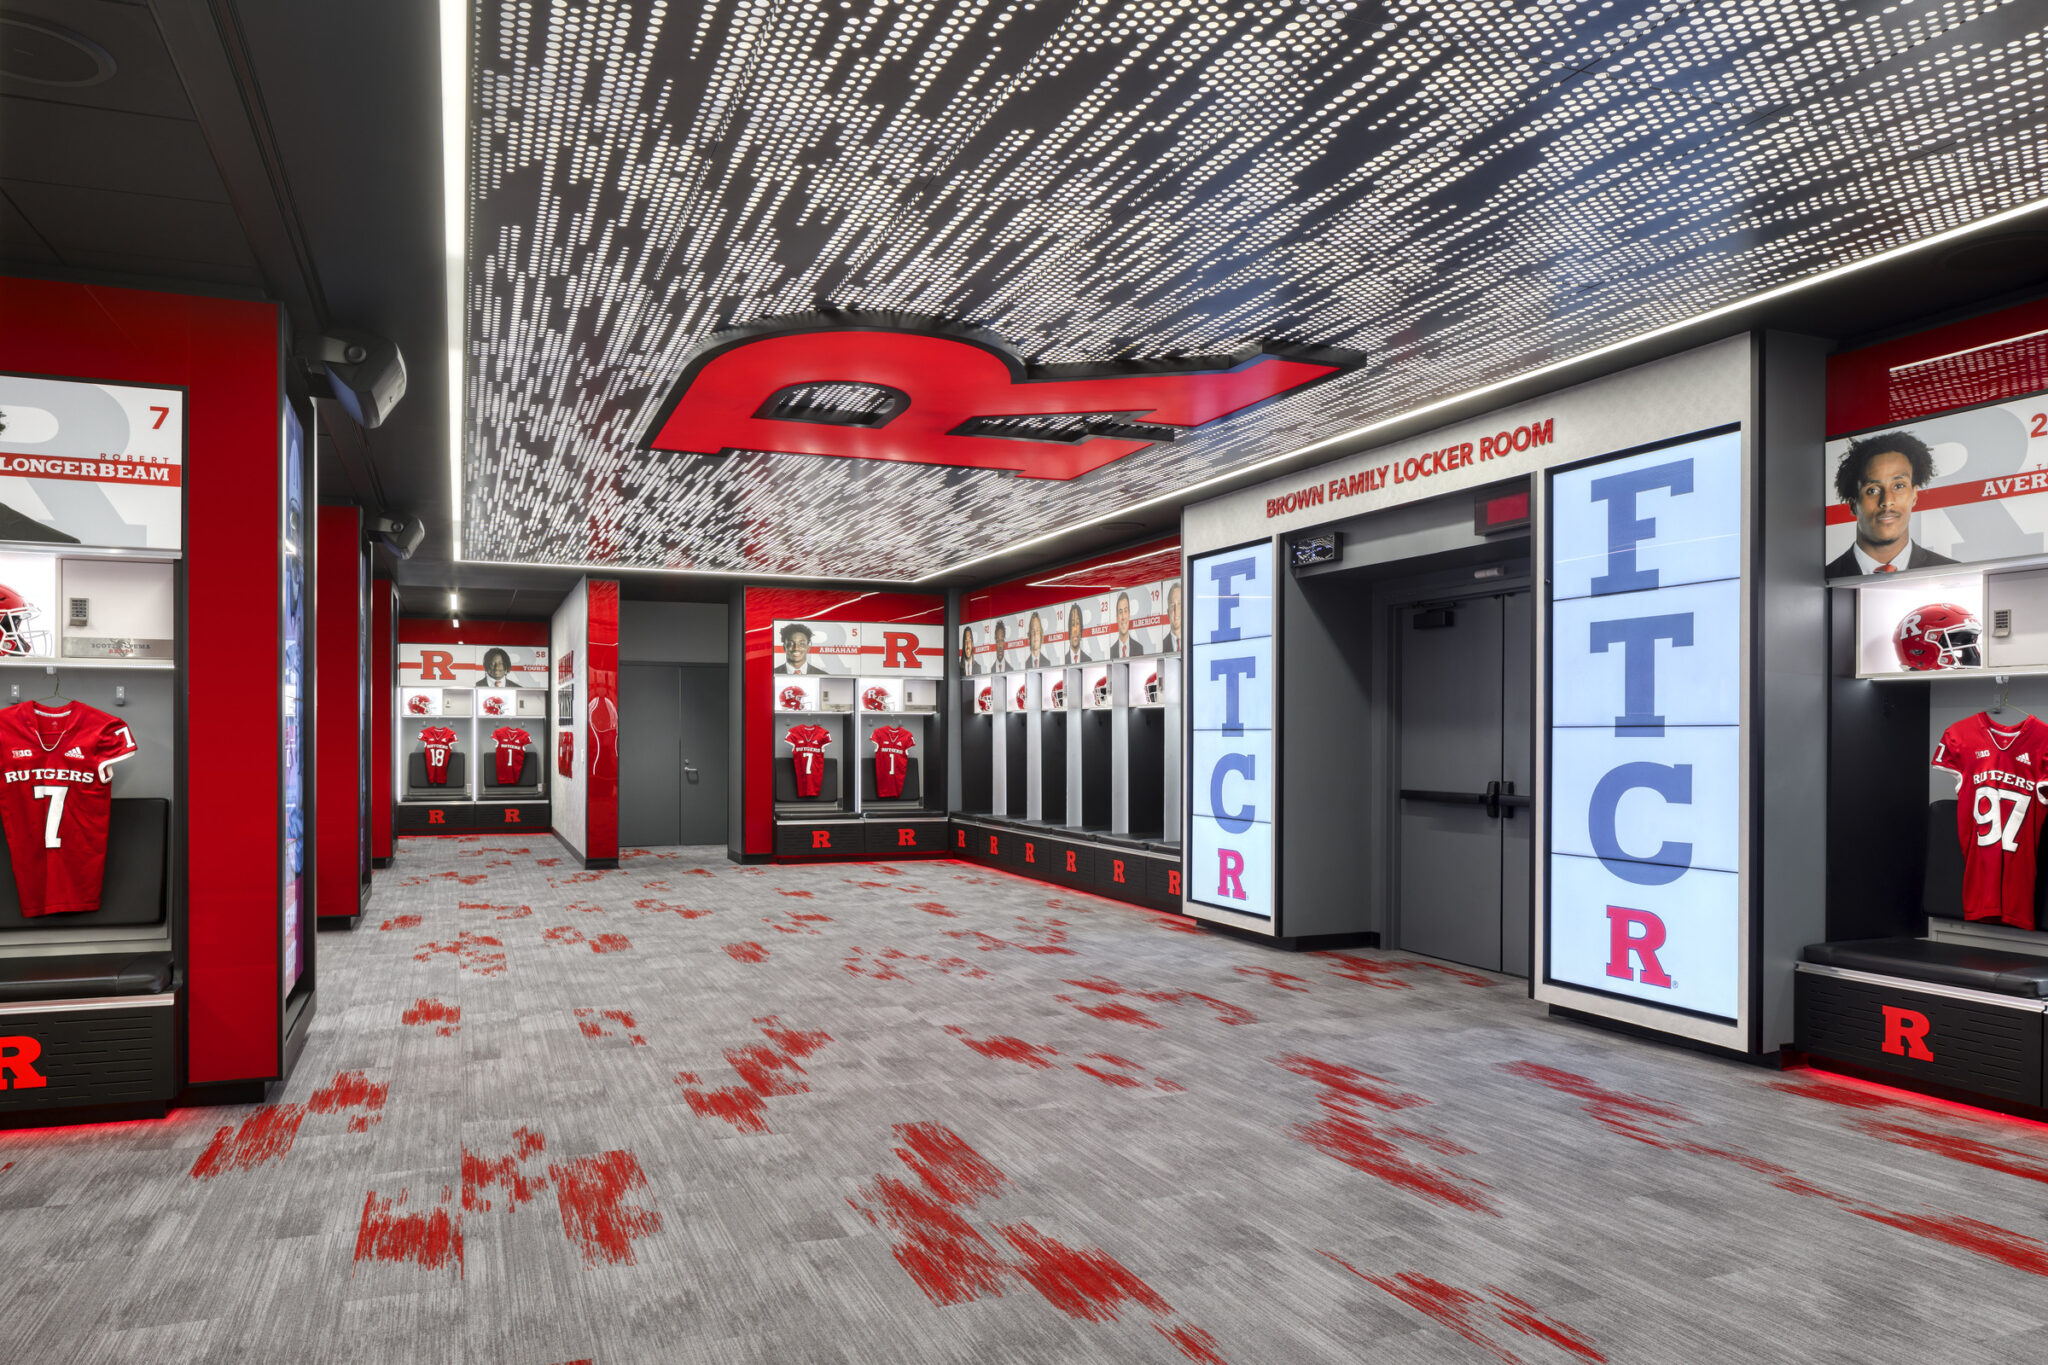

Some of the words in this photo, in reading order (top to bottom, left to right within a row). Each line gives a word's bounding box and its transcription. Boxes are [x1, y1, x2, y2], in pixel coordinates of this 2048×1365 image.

[149, 406, 170, 430] 7
[0, 457, 170, 482] LONGERBEAM
[100, 453, 169, 465] ROBERT
[1266, 484, 1325, 518] BROWN
[1328, 465, 1389, 501] FAMILY
[1393, 442, 1474, 484] LOCKER
[1479, 418, 1554, 462] ROOM
[1981, 472, 2048, 497] AVER
[1100, 601, 1109, 613] 23
[1150, 590, 1160, 602] 19
[851, 628, 858, 637] 5
[1091, 625, 1109, 635] BAILEY
[1900, 614, 1922, 640] R
[819, 646, 858, 654] ABRAHAM
[883, 631, 922, 668] R
[420, 650, 456, 680] R
[784, 689, 795, 700] R
[867, 689, 877, 699] R
[114, 726, 136, 749] 7
[430, 748, 445, 767] 18
[507, 748, 513, 767] 1
[803, 752, 813, 774] 7
[889, 753, 895, 775] 1
[4, 768, 95, 784] RUTGERS
[1973, 769, 2036, 792] RUTGERS
[33, 785, 69, 849] 7
[429, 809, 446, 824] R
[504, 808, 521, 823] R
[1973, 786, 2032, 853] 97
[811, 830, 832, 849] R
[897, 828, 917, 846] R
[957, 829, 966, 848] R
[990, 835, 999, 855] R
[1025, 842, 1035, 863] R
[1066, 850, 1077, 873] R
[1113, 859, 1126, 884] R
[1217, 848, 1248, 901] R
[1168, 870, 1181, 896] R
[1605, 905, 1672, 990] R
[1881, 1005, 1934, 1063] R
[0, 1035, 47, 1090] R
